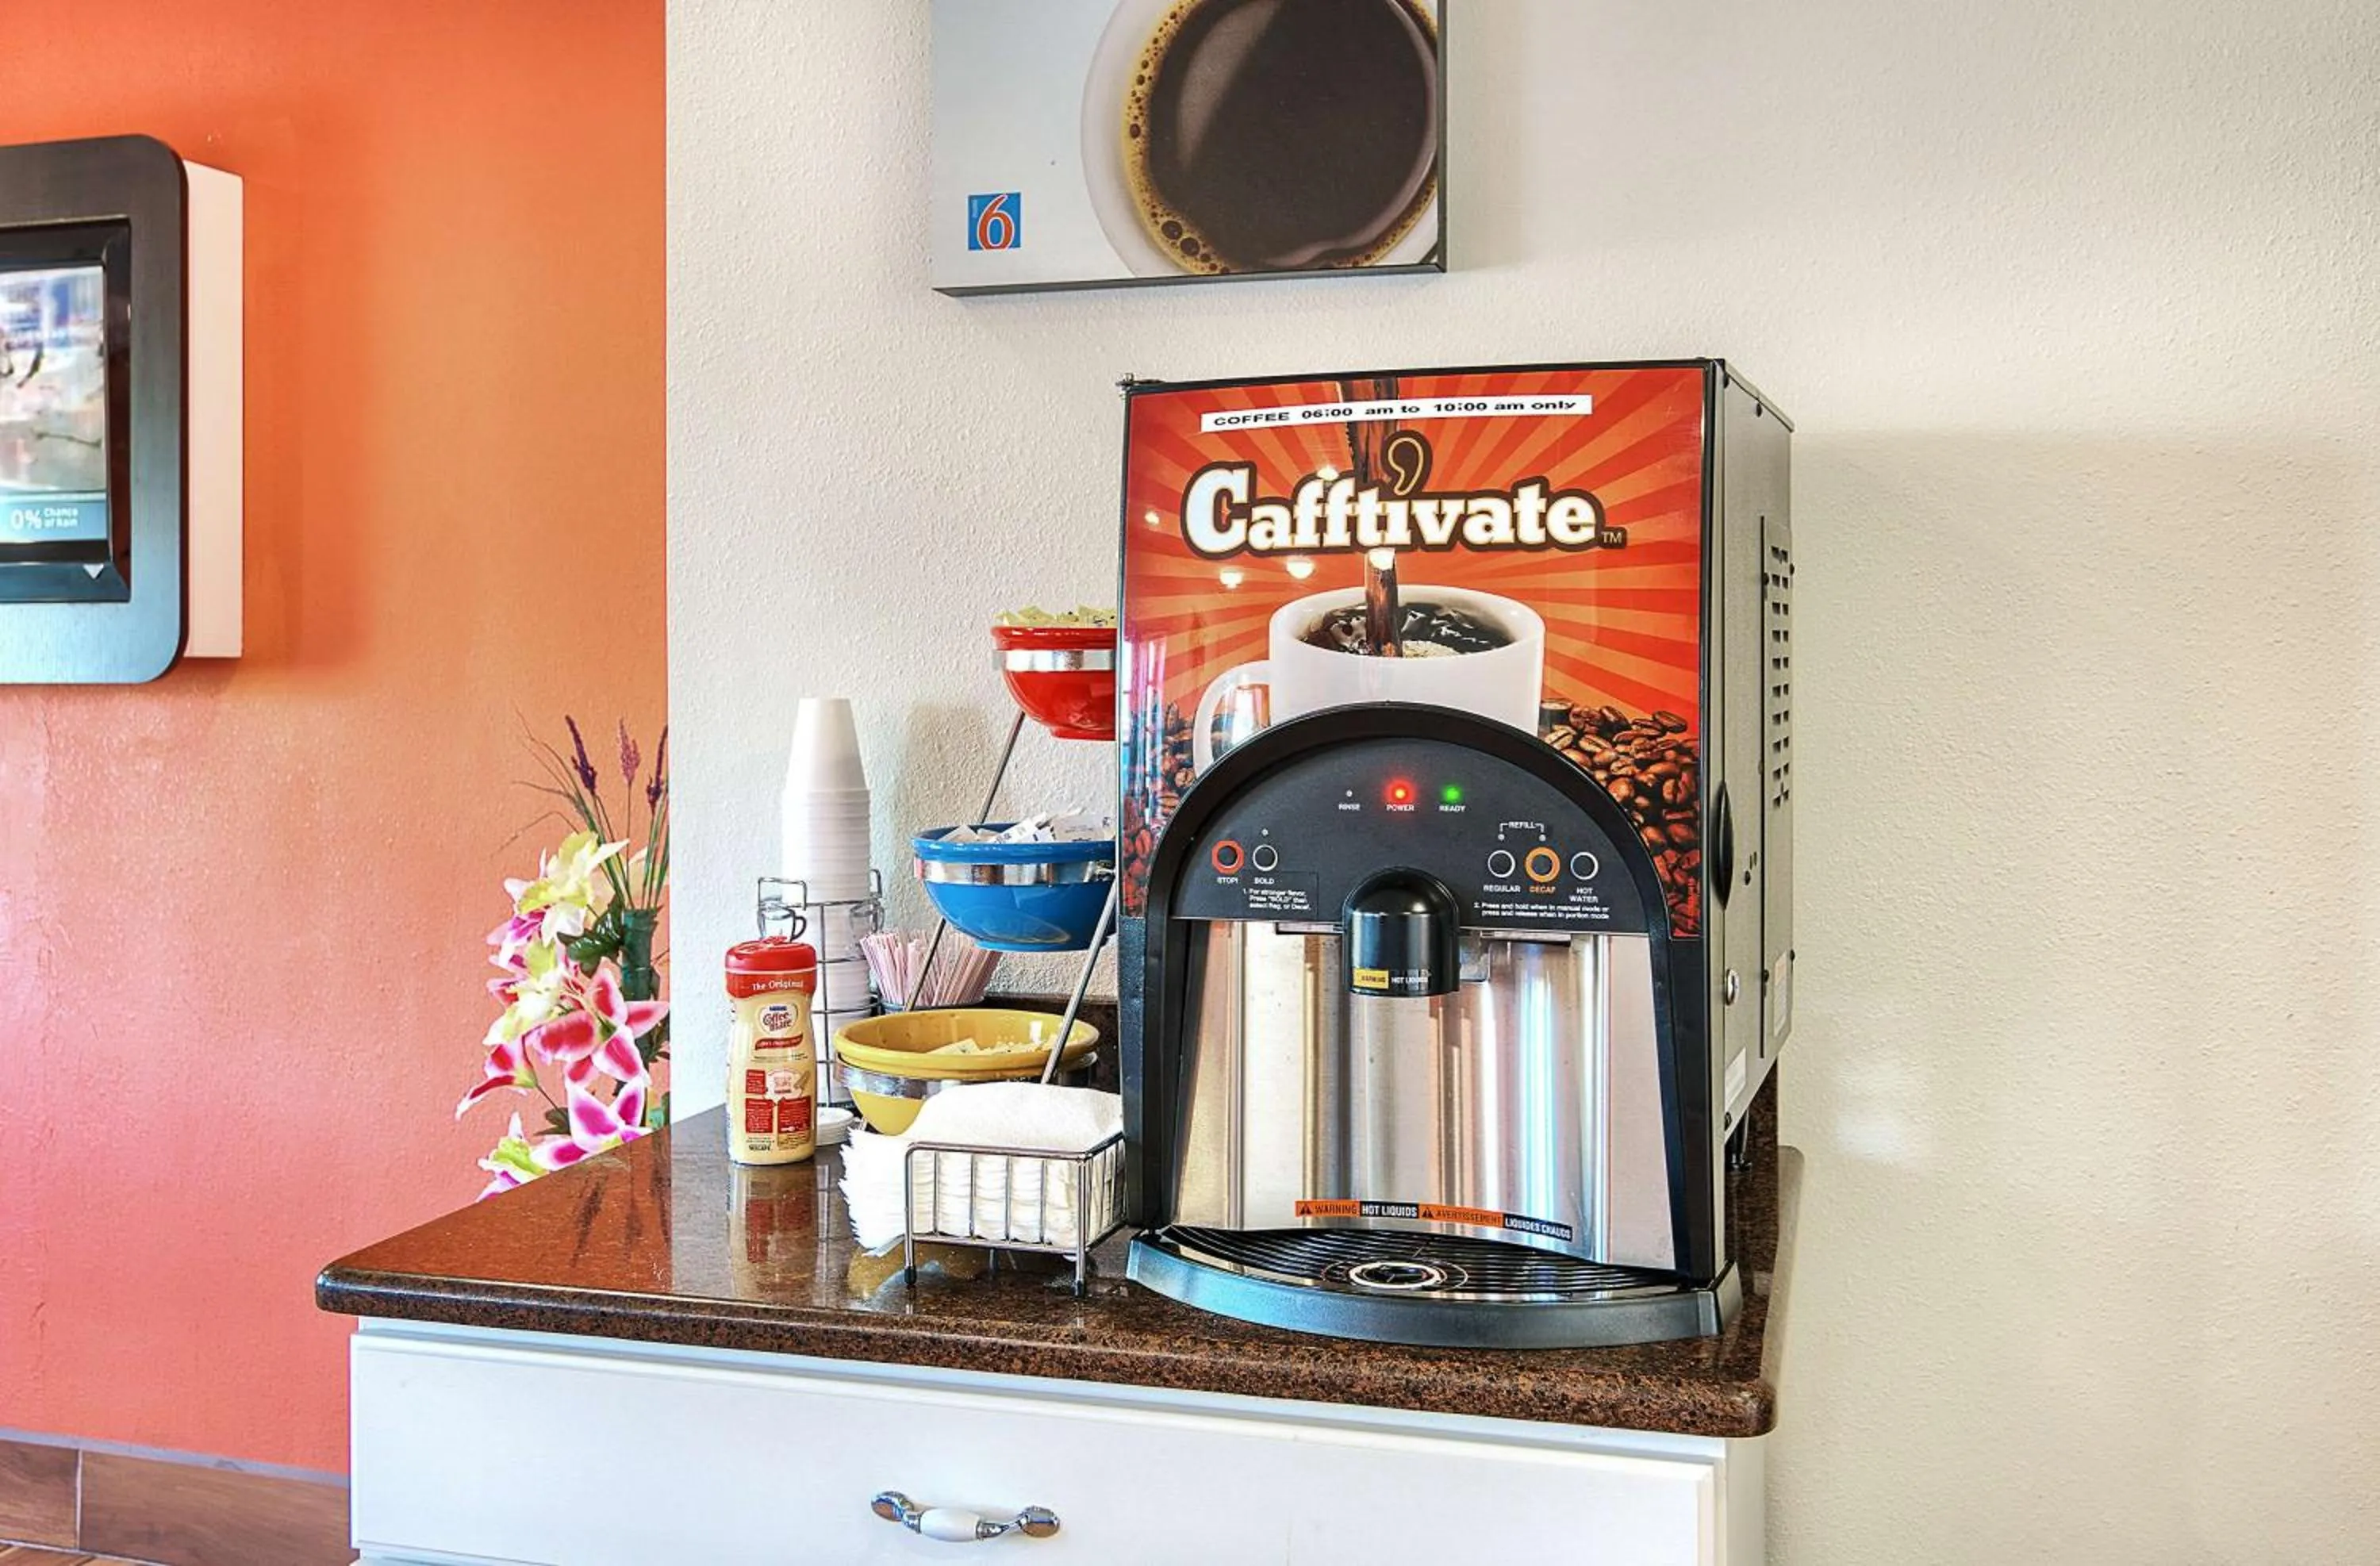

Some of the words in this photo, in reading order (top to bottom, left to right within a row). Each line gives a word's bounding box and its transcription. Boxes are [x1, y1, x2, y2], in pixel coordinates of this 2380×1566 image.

[977, 194, 1015, 251] 6
[1214, 412, 1290, 426] COFFEE
[1301, 407, 1353, 420] 06:00
[1365, 406, 1394, 415] am
[1401, 405, 1420, 414] to
[1434, 402, 1488, 413] 10:00
[1494, 402, 1525, 411] am
[1531, 400, 1576, 411] only
[11, 509, 42, 530] 0%
[1438, 804, 1466, 813] READY
[1529, 885, 1556, 894] DECAF
[1568, 895, 1599, 904] WATER
[768, 979, 804, 989] Original
[1315, 1203, 1357, 1215] WARNING
[1361, 1205, 1379, 1215] HOT
[1381, 1206, 1417, 1218] LIQUIDS
[1437, 1210, 1502, 1226] AVERTISSEMENT
[1505, 1217, 1540, 1233] LIQUIDES
[1541, 1226, 1572, 1240] CHAUDS
